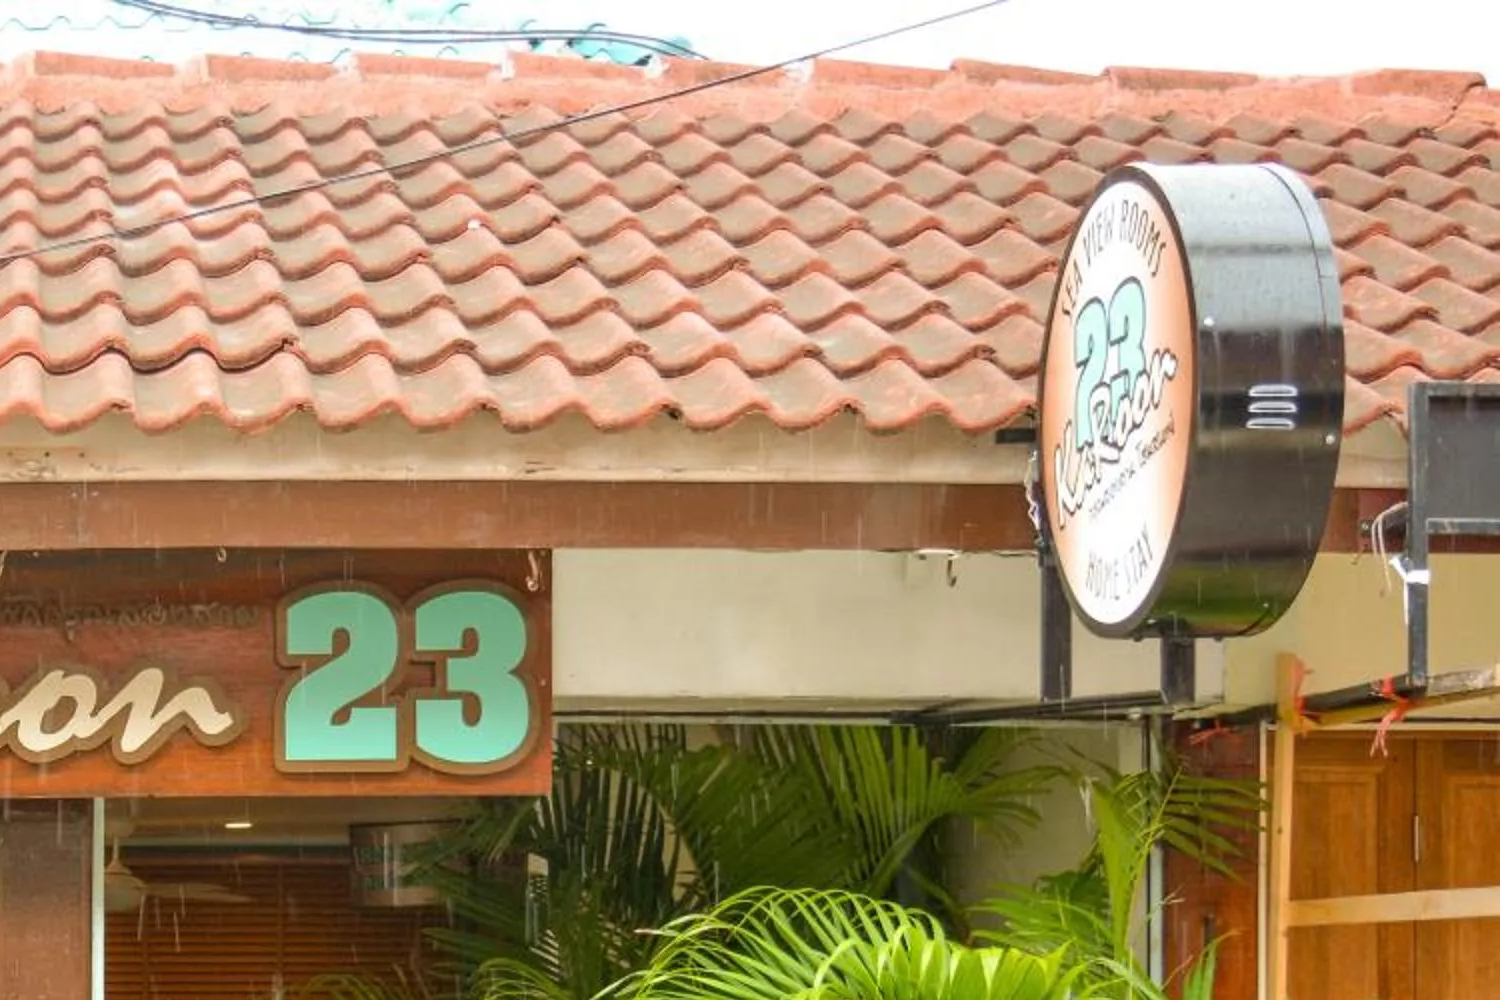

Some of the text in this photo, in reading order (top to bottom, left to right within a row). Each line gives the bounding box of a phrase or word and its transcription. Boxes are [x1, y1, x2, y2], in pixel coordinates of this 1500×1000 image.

[1061, 199, 1167, 325] SEA VIEW ROOMS
[1074, 275, 1147, 450] 23
[1085, 520, 1153, 601] HOME STAY
[282, 588, 532, 765] 23
